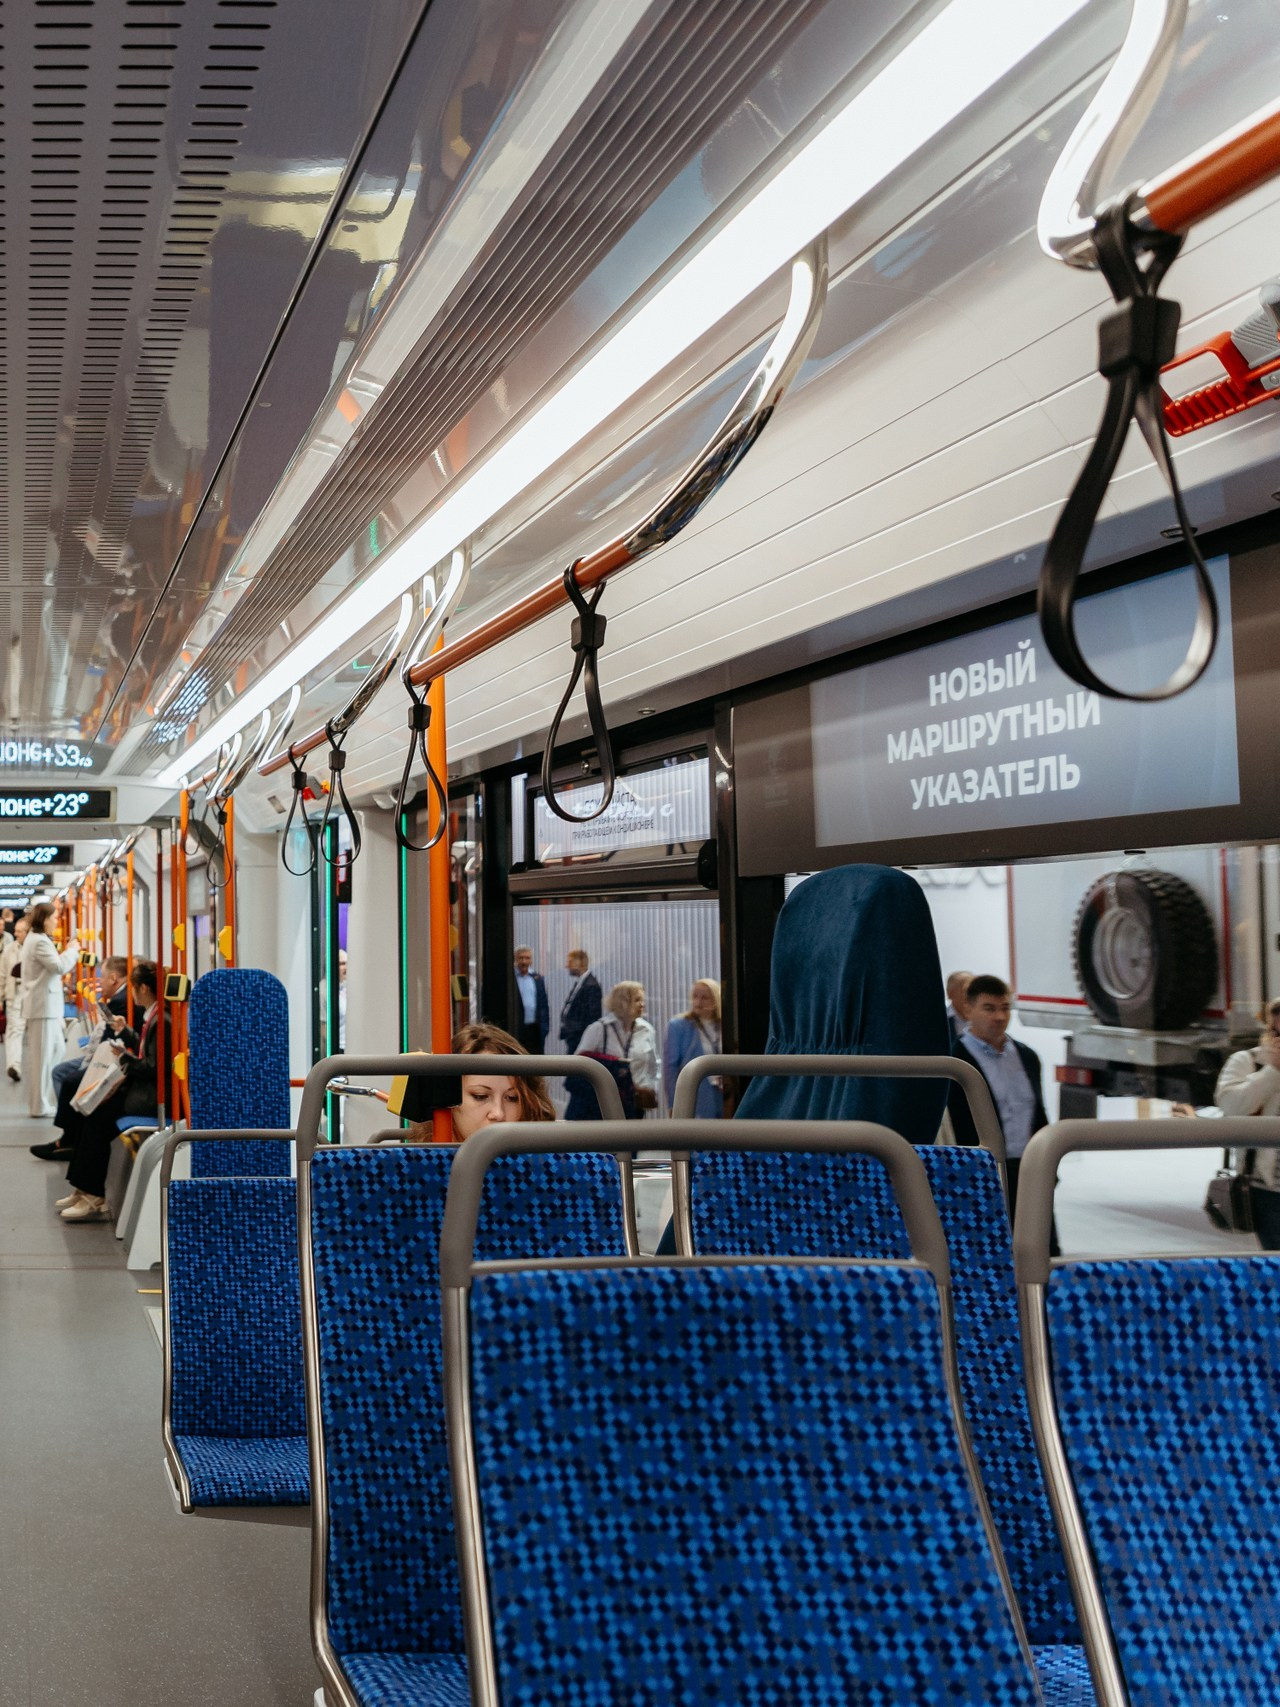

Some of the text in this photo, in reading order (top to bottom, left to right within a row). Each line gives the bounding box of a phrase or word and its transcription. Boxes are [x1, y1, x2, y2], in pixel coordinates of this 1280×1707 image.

[929, 639, 1036, 706] НОВЫЙ
[887, 690, 1101, 764] МАРШРУТНЫЙ
[910, 754, 1081, 810] УКАЗАТЕЛЬ
